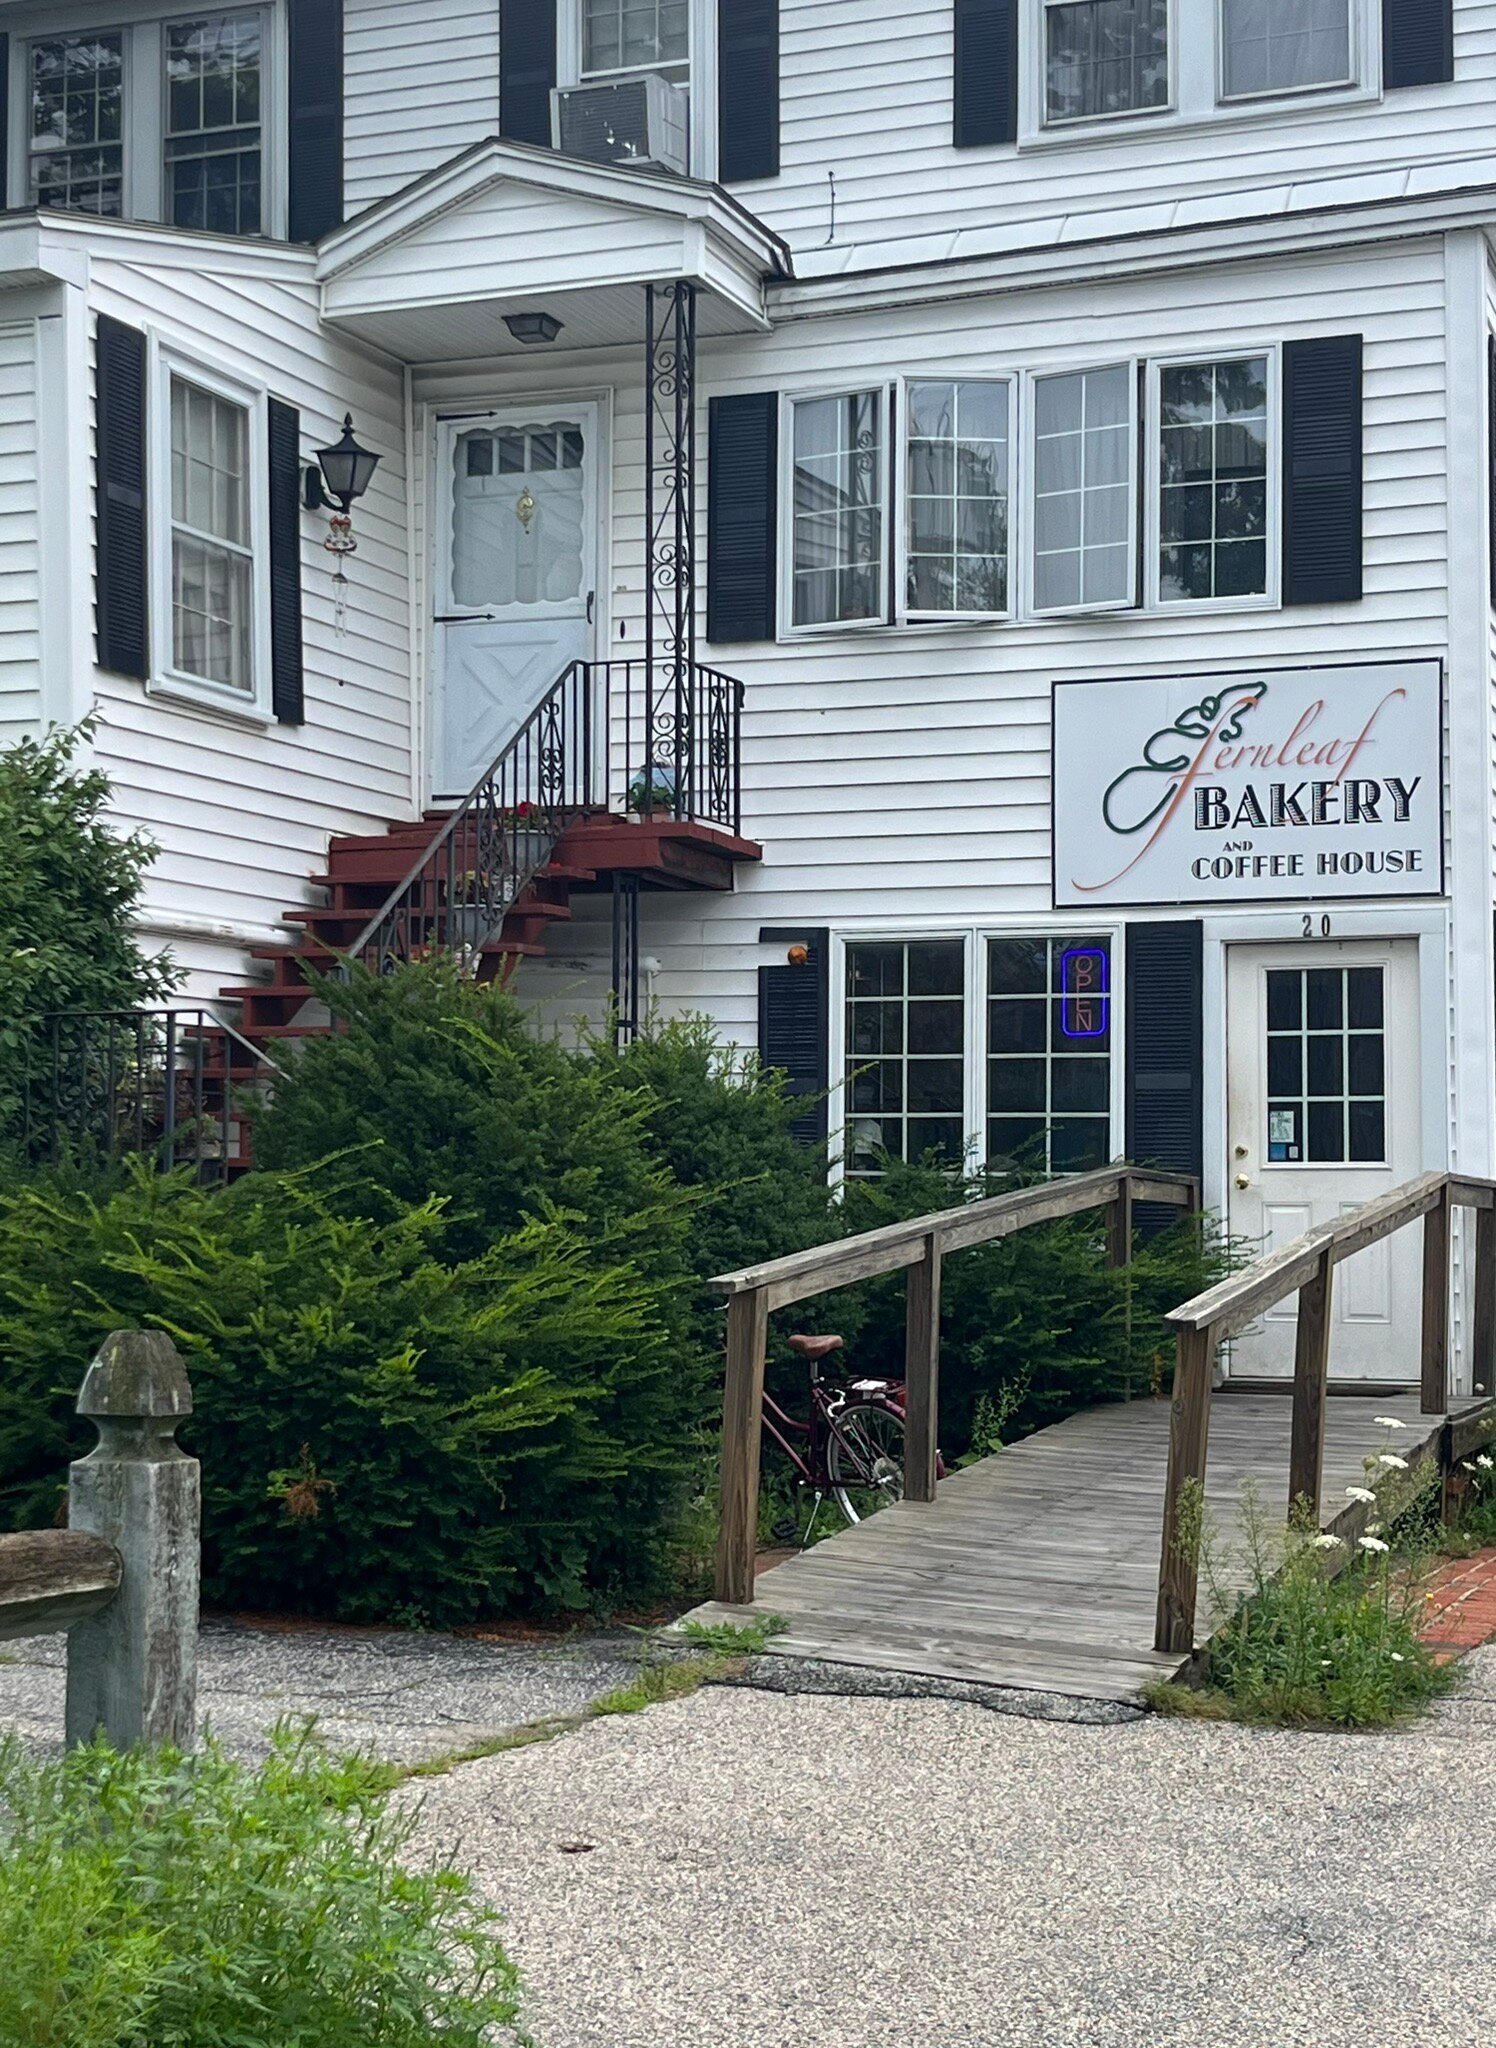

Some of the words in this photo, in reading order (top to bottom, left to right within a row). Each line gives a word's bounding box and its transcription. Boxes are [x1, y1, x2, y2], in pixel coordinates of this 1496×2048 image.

[1194, 776, 1422, 830] BAKERY
[1222, 840, 1254, 852] AND
[1191, 854, 1305, 880] COFFEE
[1316, 850, 1423, 875] HOUSE
[1302, 914, 1330, 938] 20
[1075, 955, 1093, 1031] OPEN
